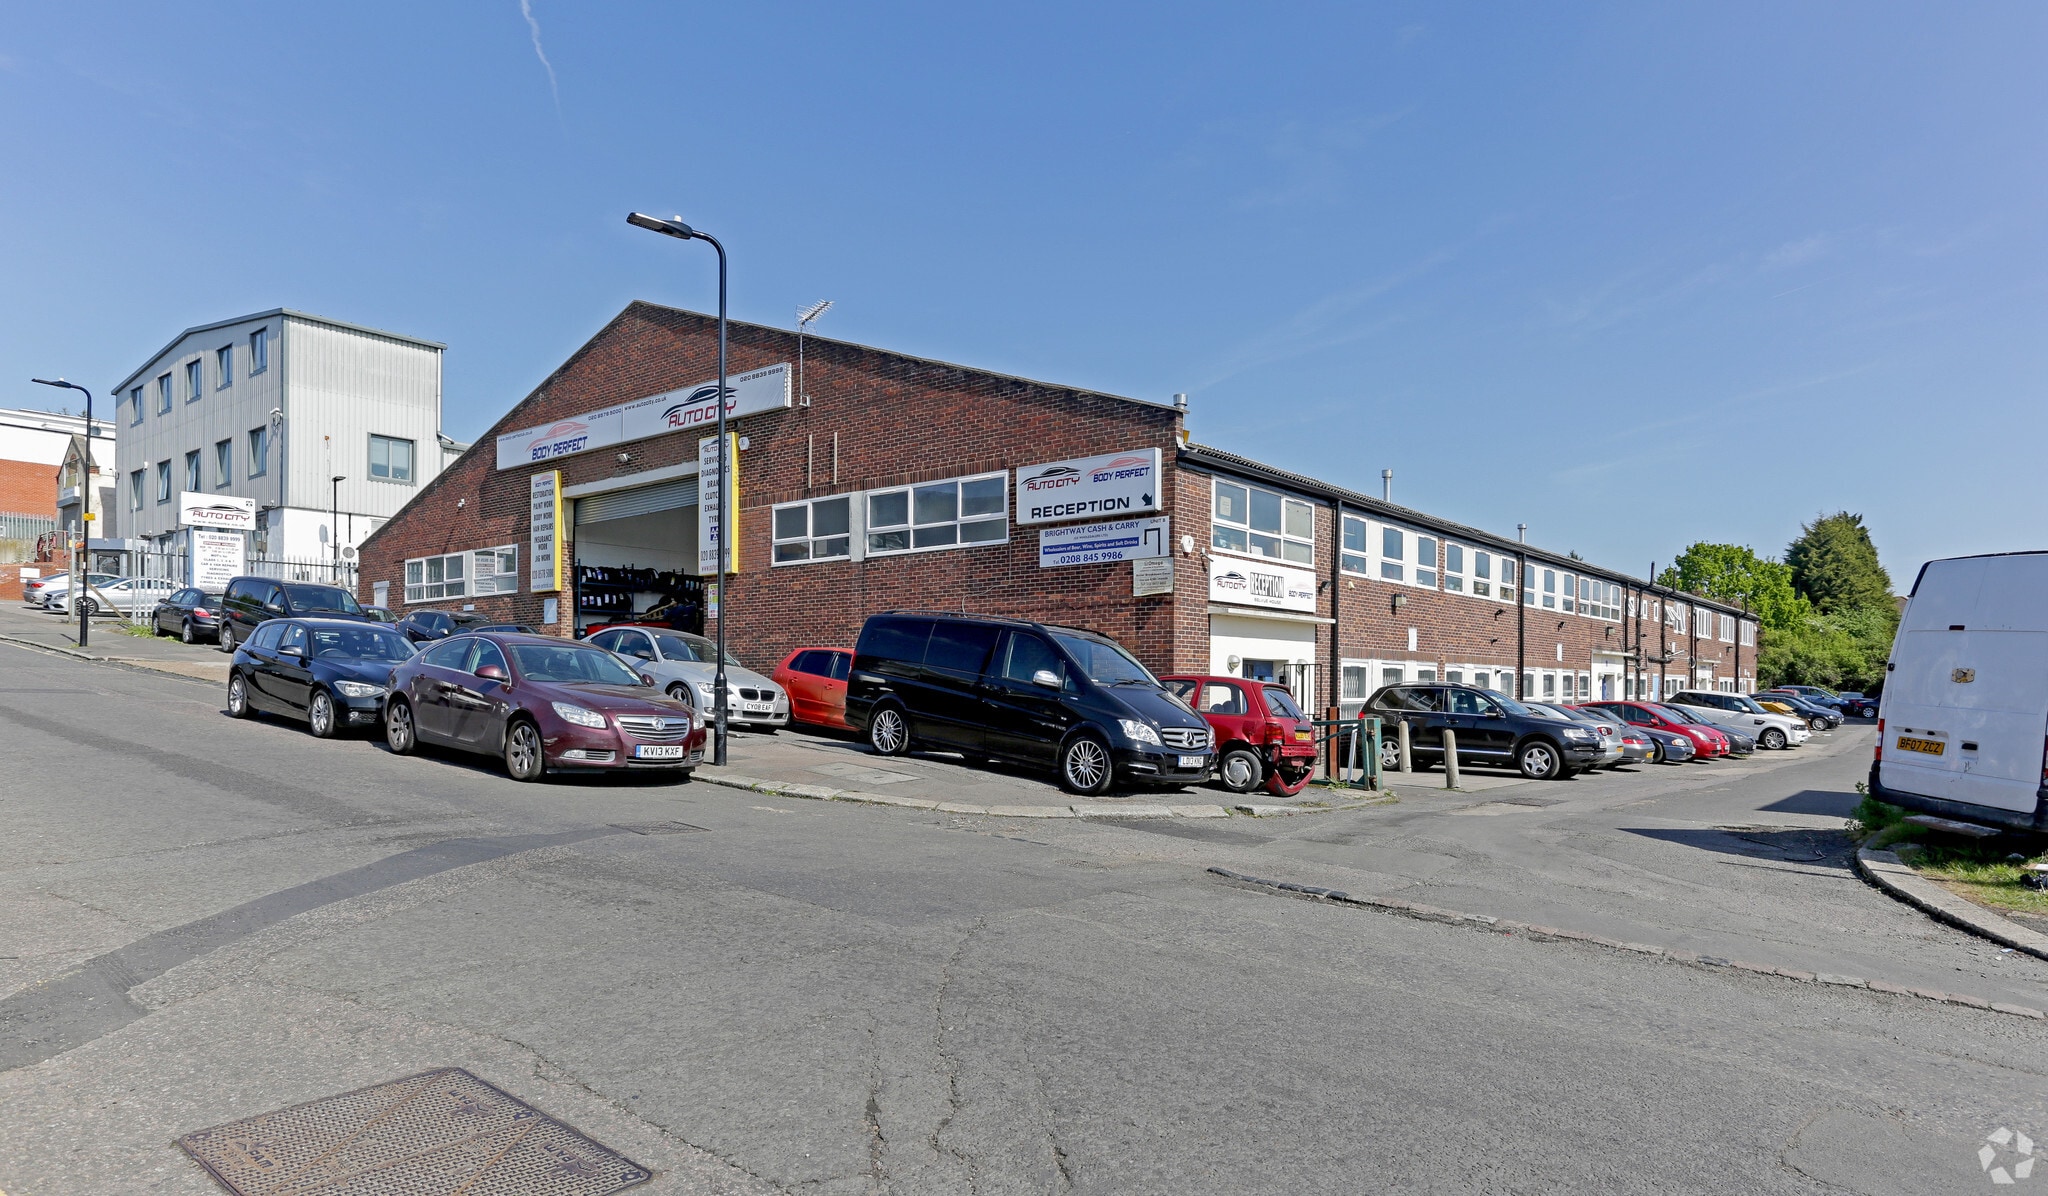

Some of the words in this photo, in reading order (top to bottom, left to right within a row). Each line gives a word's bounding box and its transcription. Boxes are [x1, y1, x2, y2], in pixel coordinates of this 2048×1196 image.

[752, 371, 767, 380] 8839
[768, 366, 783, 375] 9999
[668, 408, 703, 428] AUTO
[705, 400, 737, 420] CIY
[532, 444, 552, 460] BODY
[553, 436, 588, 456] PERFECT
[1093, 472, 1114, 483] BODY
[1115, 467, 1150, 480] PERFECT
[1027, 480, 1055, 491] AUTO
[1056, 477, 1080, 487] CITY
[192, 511, 223, 519] AUTO
[1031, 497, 1130, 519] RECEPTION
[1044, 527, 1086, 537] BRIGHTWAY
[1088, 524, 1106, 533] CASH
[1115, 521, 1140, 530] CARRY
[1060, 555, 1080, 564] 0208
[1083, 553, 1099, 561] 845
[1102, 551, 1122, 560] 9986
[1250, 572, 1284, 598] RECEPTION
[644, 747, 663, 756] KV13
[665, 747, 680, 756] KXF
[1900, 739, 1922, 750] BF07
[1923, 742, 1941, 753] ZCZ
